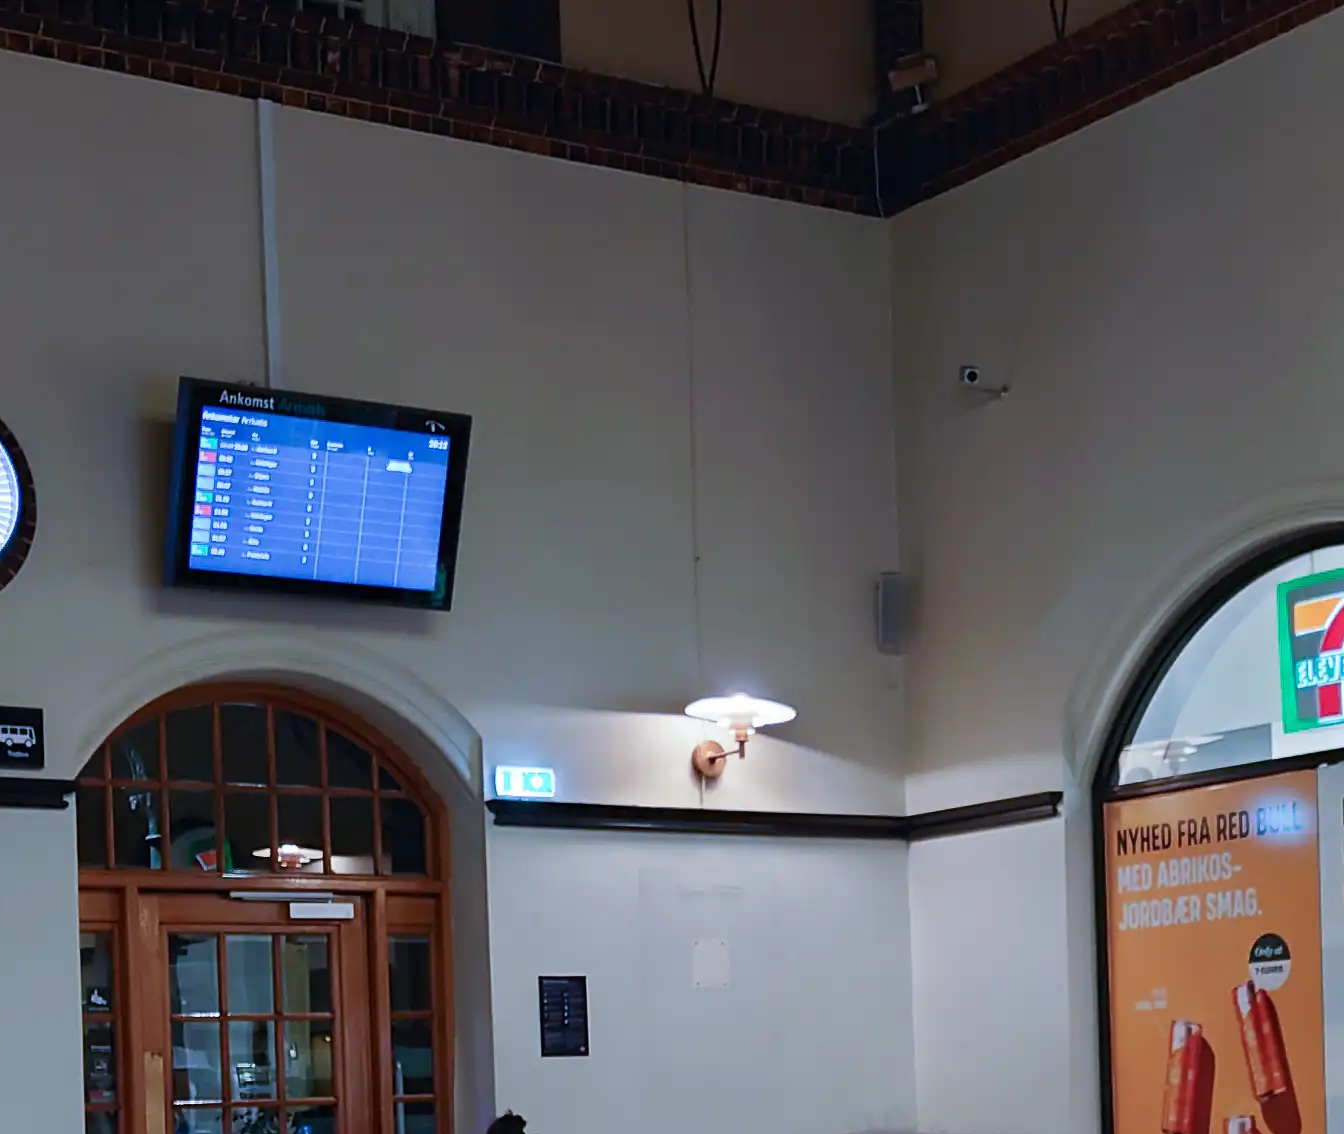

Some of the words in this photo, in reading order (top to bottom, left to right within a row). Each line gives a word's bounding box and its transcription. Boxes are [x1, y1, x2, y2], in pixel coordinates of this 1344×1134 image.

[219, 389, 276, 410] Ankomst
[1116, 823, 1171, 856] NYHED
[1177, 816, 1211, 848] FRA
[1216, 810, 1250, 842] RED
[1117, 863, 1152, 894] MED
[1157, 852, 1242, 889] ABRIKOS-
[1118, 896, 1201, 931] JORDBÆR
[1206, 887, 1263, 921] SMAG.
